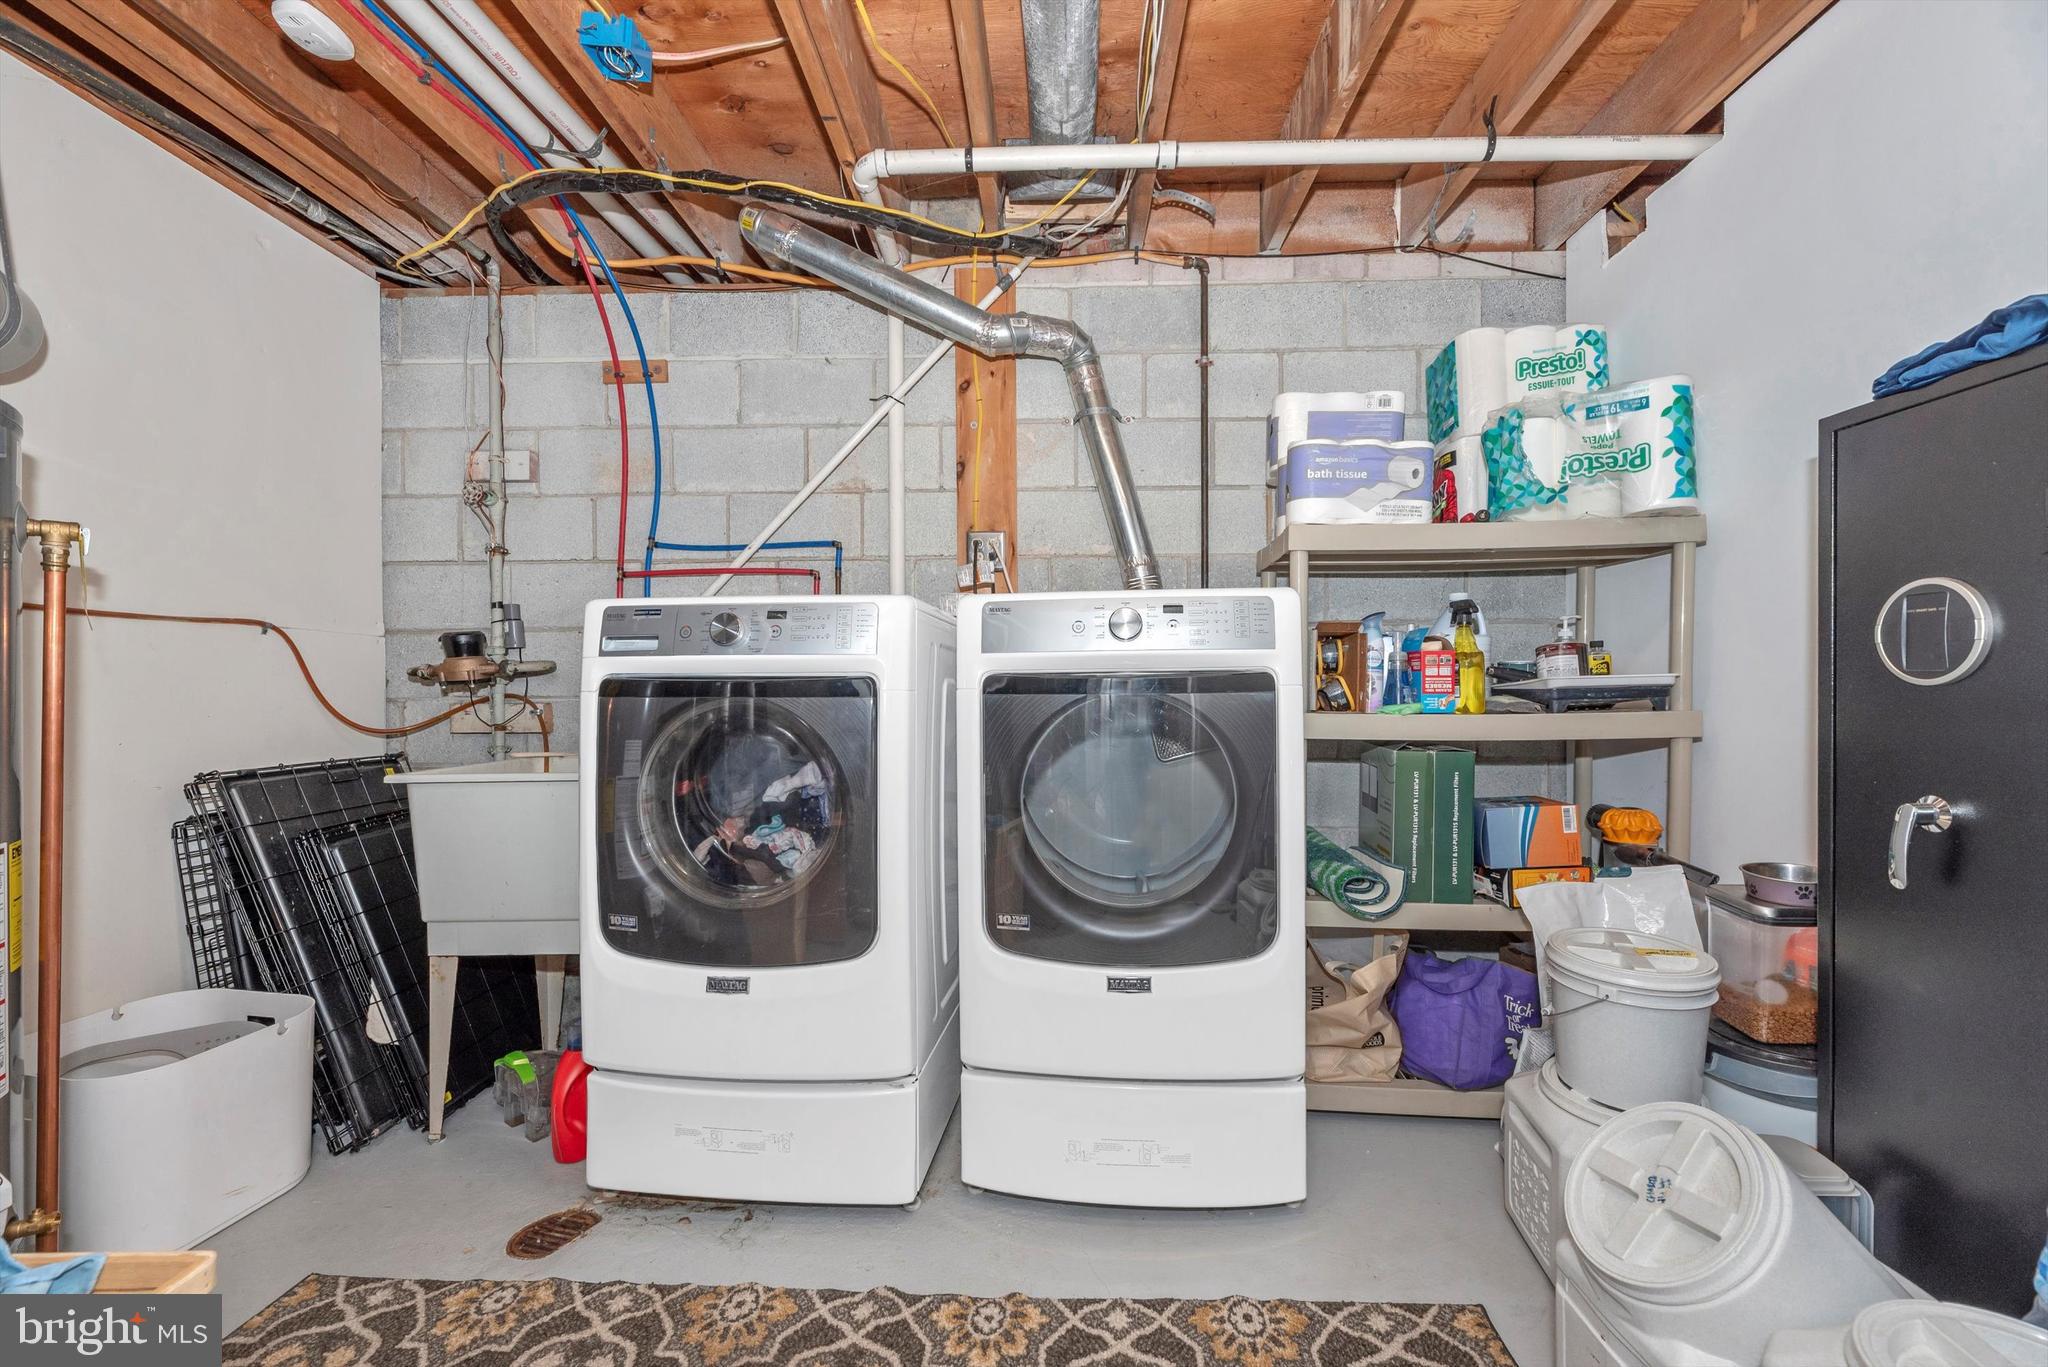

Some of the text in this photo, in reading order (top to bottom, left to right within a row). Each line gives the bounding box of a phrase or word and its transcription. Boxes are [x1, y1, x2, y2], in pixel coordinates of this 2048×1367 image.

[1517, 349, 1585, 380] Presto!
[1528, 376, 1576, 391] ESSUIE-TOUT
[1610, 403, 1621, 414] 19
[1559, 444, 1650, 481] Presto!
[1307, 469, 1368, 479] bath tissue
[610, 915, 621, 925] 10
[998, 915, 1011, 924] 10
[1503, 994, 1535, 1018] Trick
[1512, 1014, 1521, 1022] or
